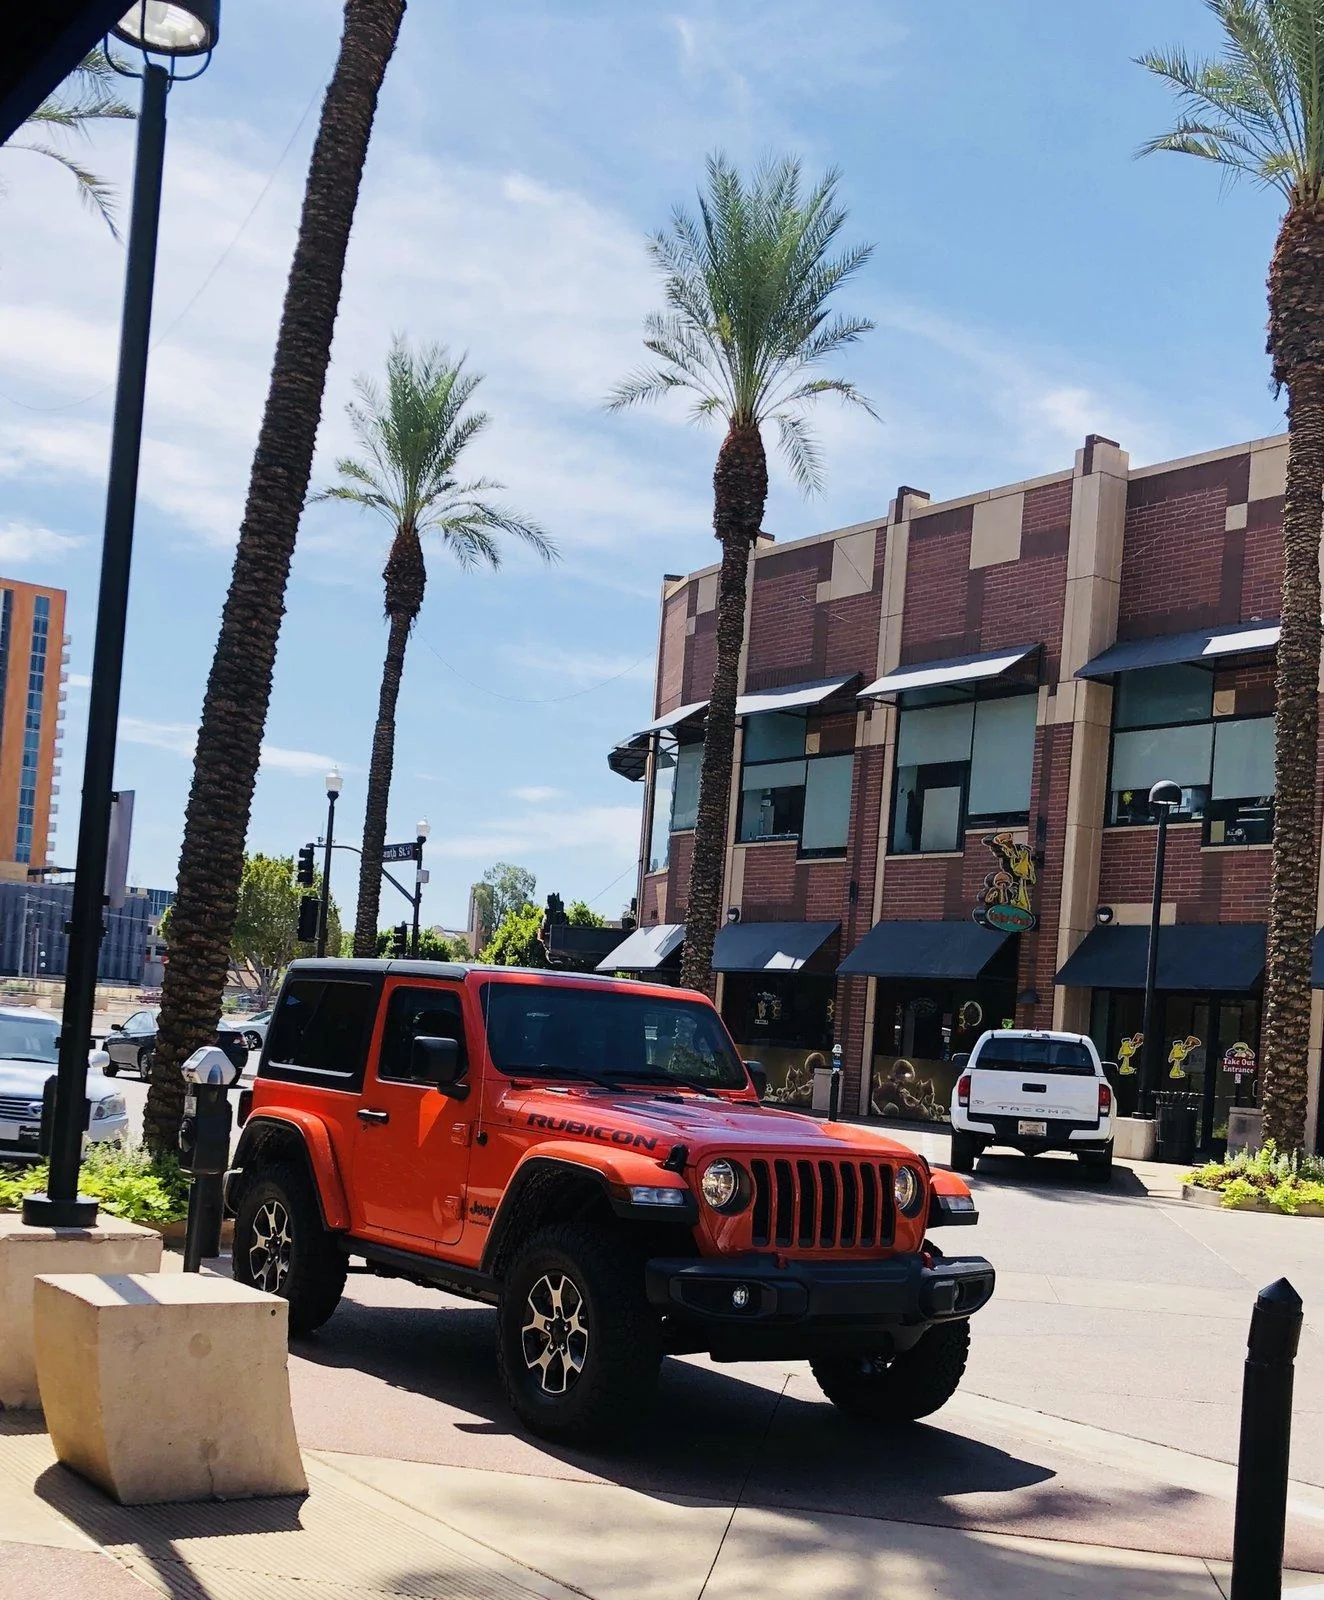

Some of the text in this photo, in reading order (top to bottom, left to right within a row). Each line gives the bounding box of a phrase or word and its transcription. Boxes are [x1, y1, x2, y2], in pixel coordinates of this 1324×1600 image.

[1223, 1057, 1240, 1065] Take
[1223, 1065, 1254, 1074] Entrance
[997, 1105, 1071, 1115] TACOMA
[527, 1113, 658, 1151] RUBICON
